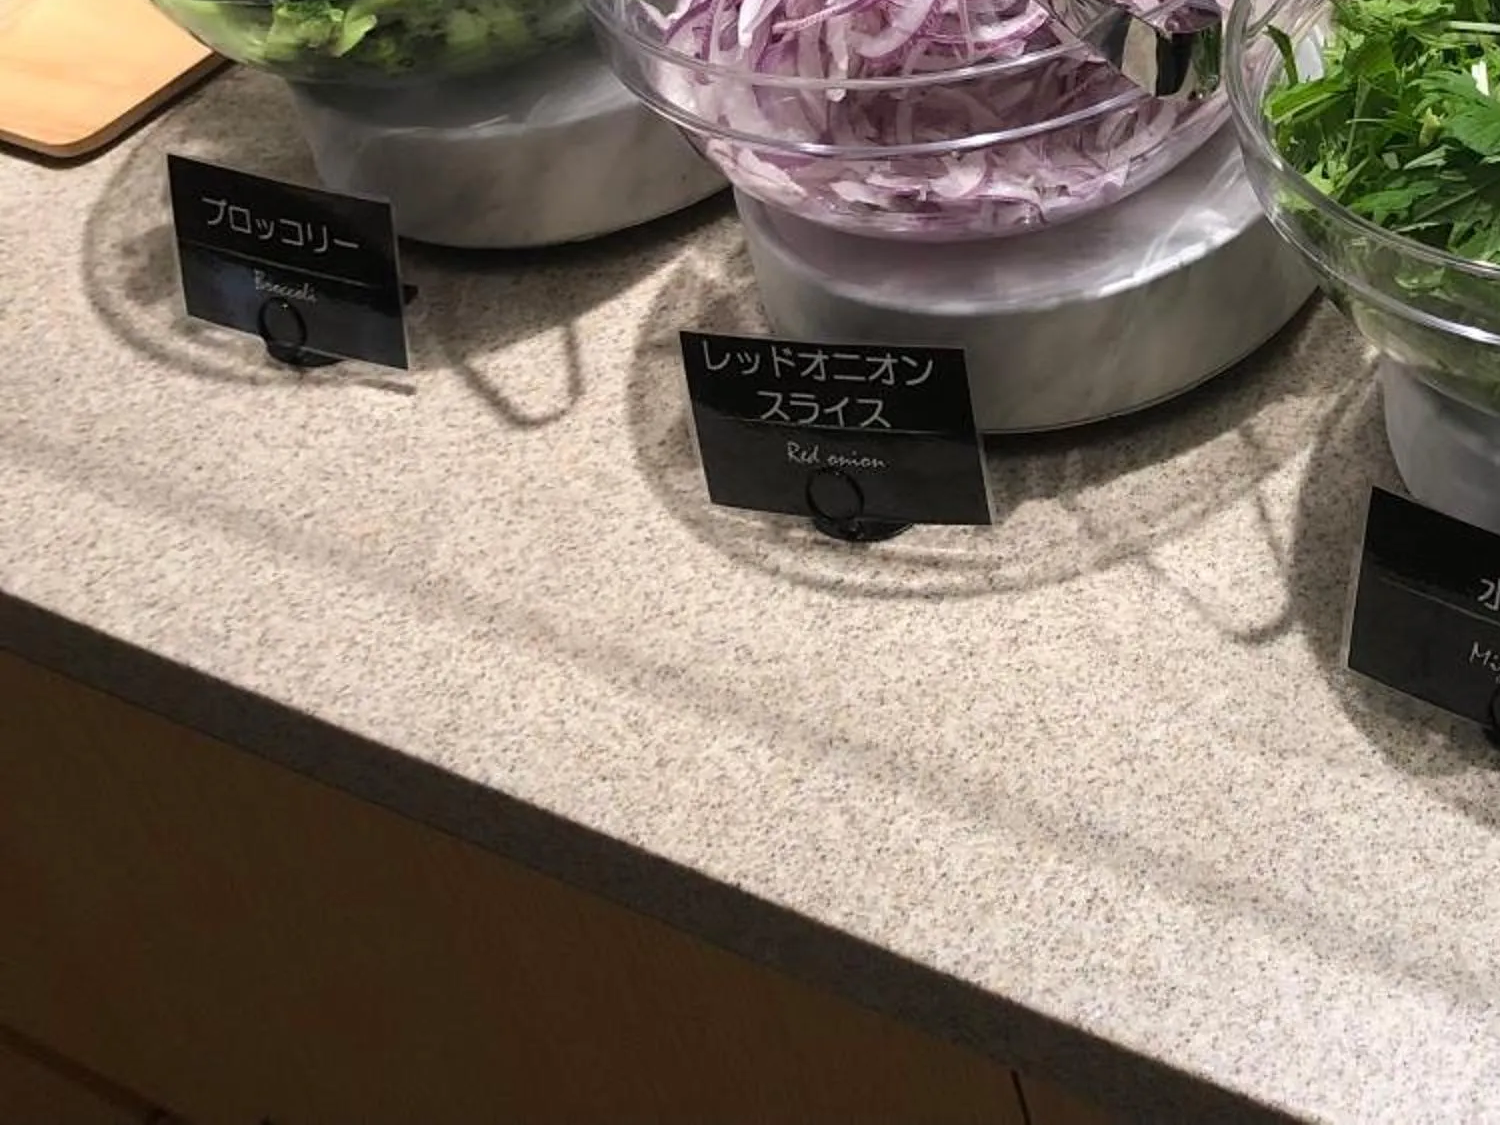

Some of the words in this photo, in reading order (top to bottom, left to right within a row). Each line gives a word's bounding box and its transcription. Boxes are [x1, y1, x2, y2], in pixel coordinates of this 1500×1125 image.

[703, 340, 934, 386] レッドオニオン
[757, 391, 892, 427] スライス
[787, 441, 822, 464] Red
[827, 450, 887, 468] onion
